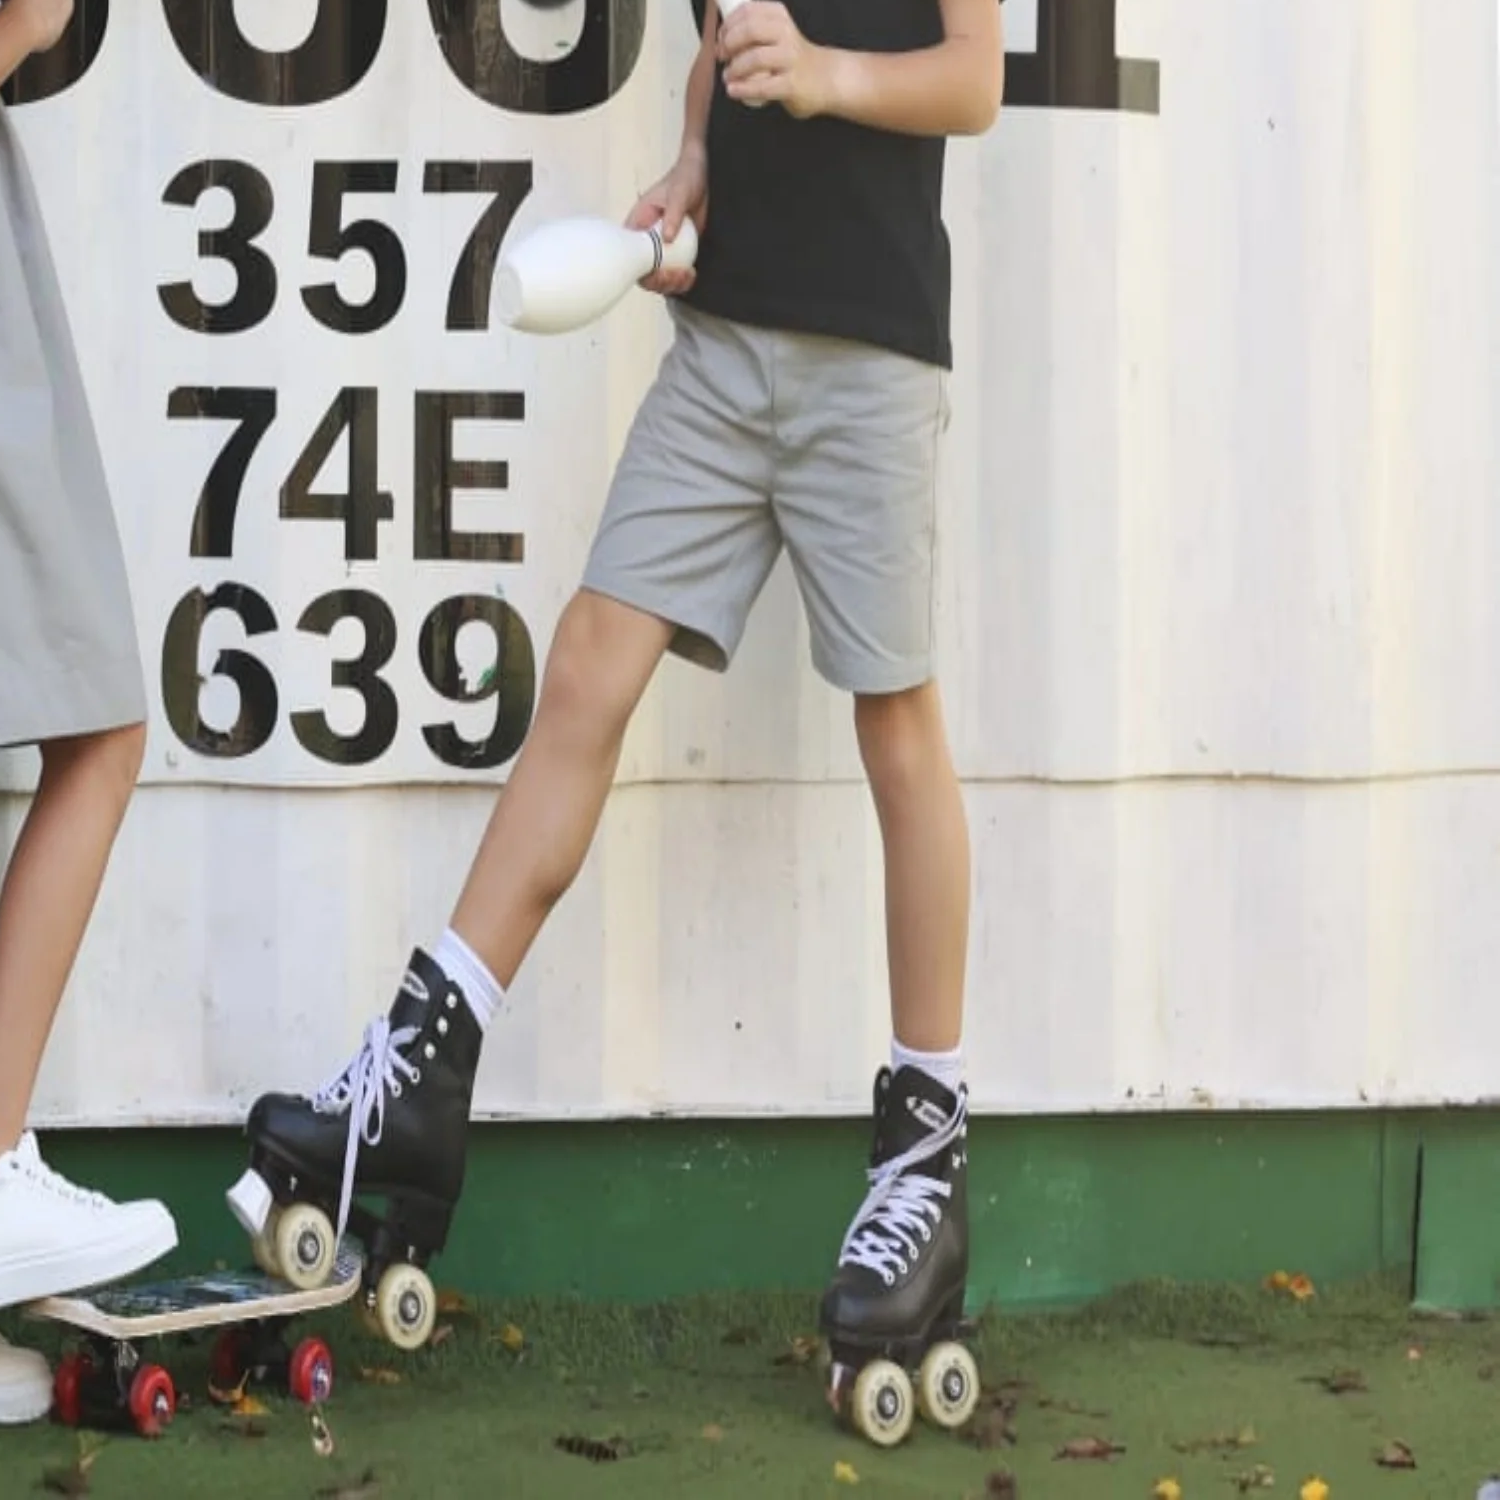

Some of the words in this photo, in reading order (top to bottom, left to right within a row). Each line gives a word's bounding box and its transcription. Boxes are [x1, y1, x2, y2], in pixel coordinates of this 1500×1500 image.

[157, 157, 533, 334] 357
[166, 385, 526, 563] 74E
[161, 581, 536, 770] 639
